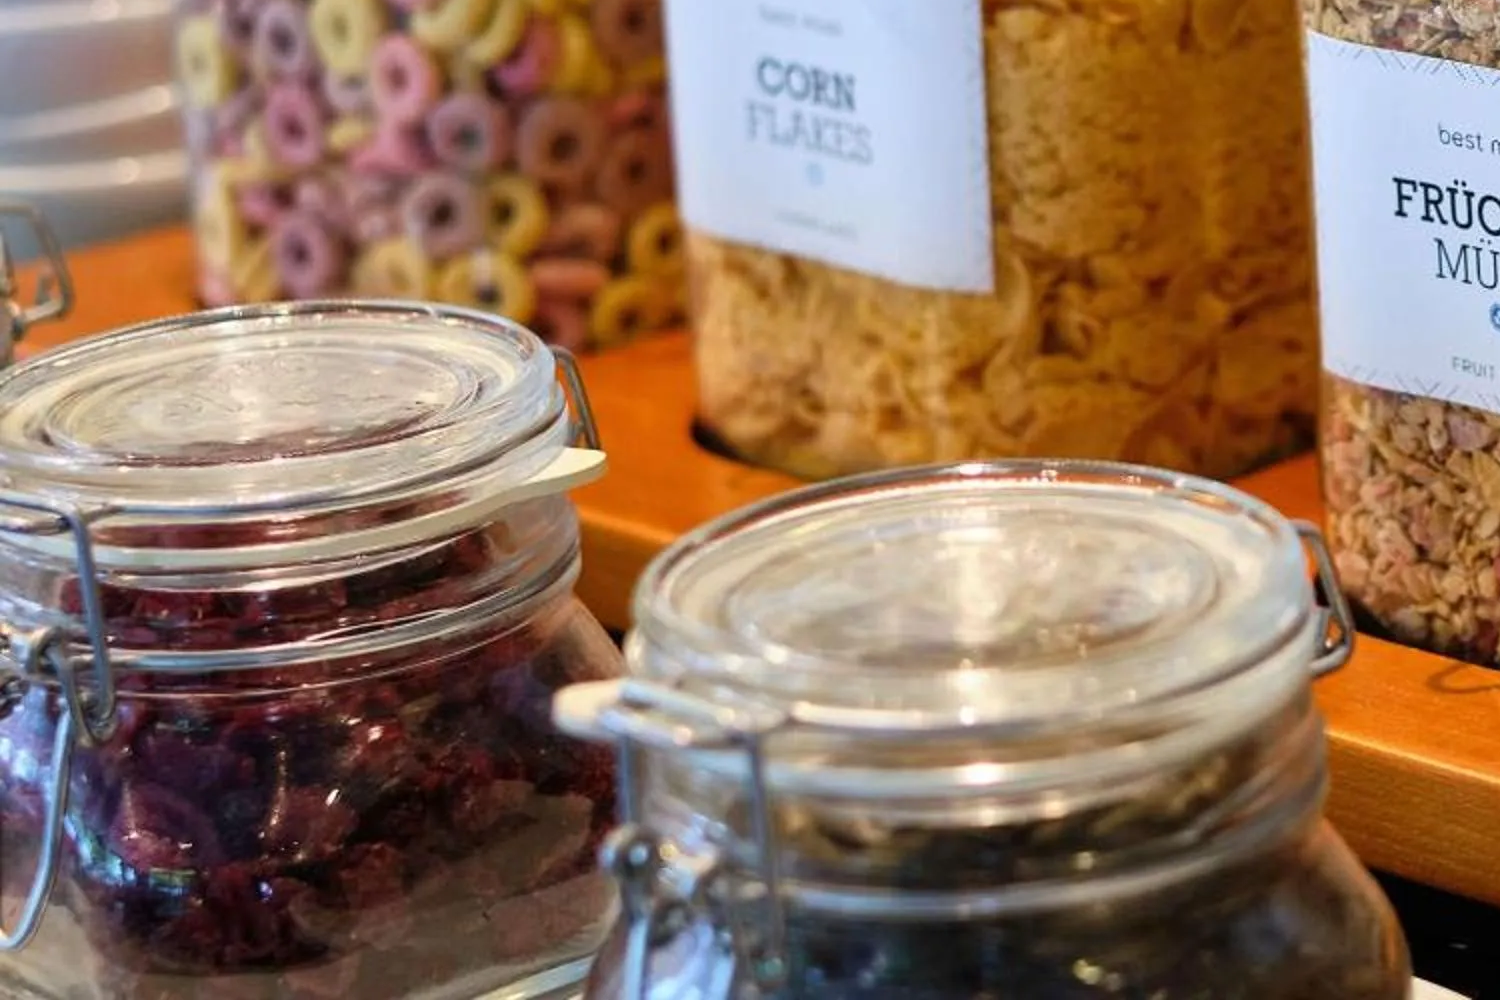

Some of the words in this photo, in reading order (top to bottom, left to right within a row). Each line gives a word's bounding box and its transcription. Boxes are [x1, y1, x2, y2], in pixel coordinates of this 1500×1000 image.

[756, 56, 856, 112] CORN
[1438, 124, 1484, 152] best
[1452, 357, 1496, 382] FRUIT
